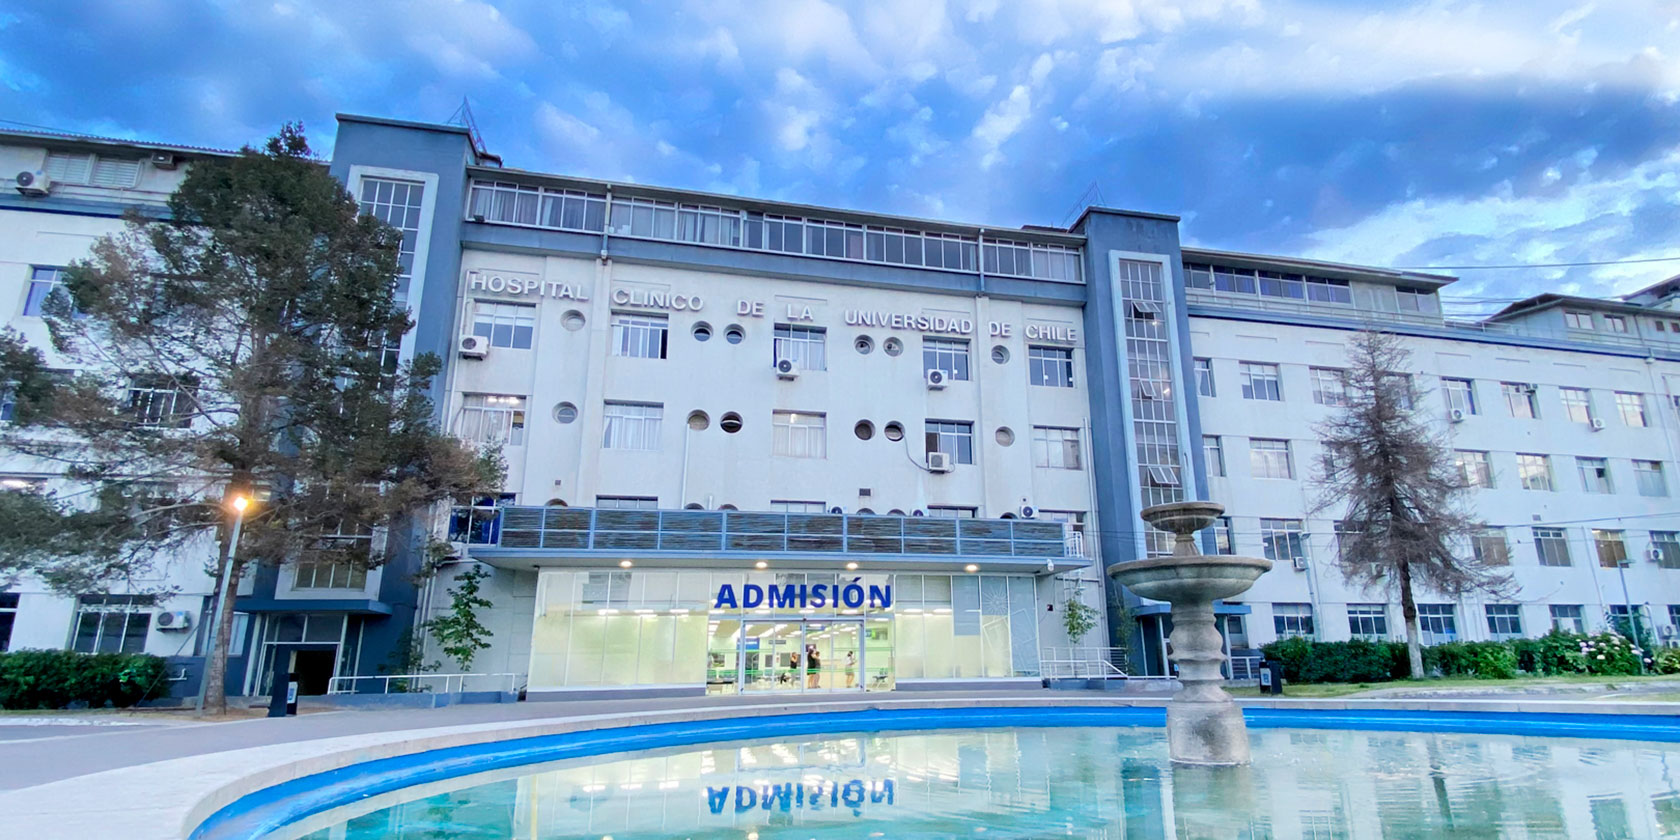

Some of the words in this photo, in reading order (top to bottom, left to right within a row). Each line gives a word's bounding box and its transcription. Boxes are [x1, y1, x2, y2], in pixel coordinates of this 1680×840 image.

[470, 273, 588, 301] HOSPITAL
[612, 288, 704, 312] CLINICO
[737, 299, 764, 317] DE
[787, 304, 814, 322] LA
[844, 310, 974, 335] UNIVERSIDAD
[988, 321, 1012, 337] DE
[1025, 325, 1078, 342] CHILE
[714, 577, 891, 608] ADMISIÓN
